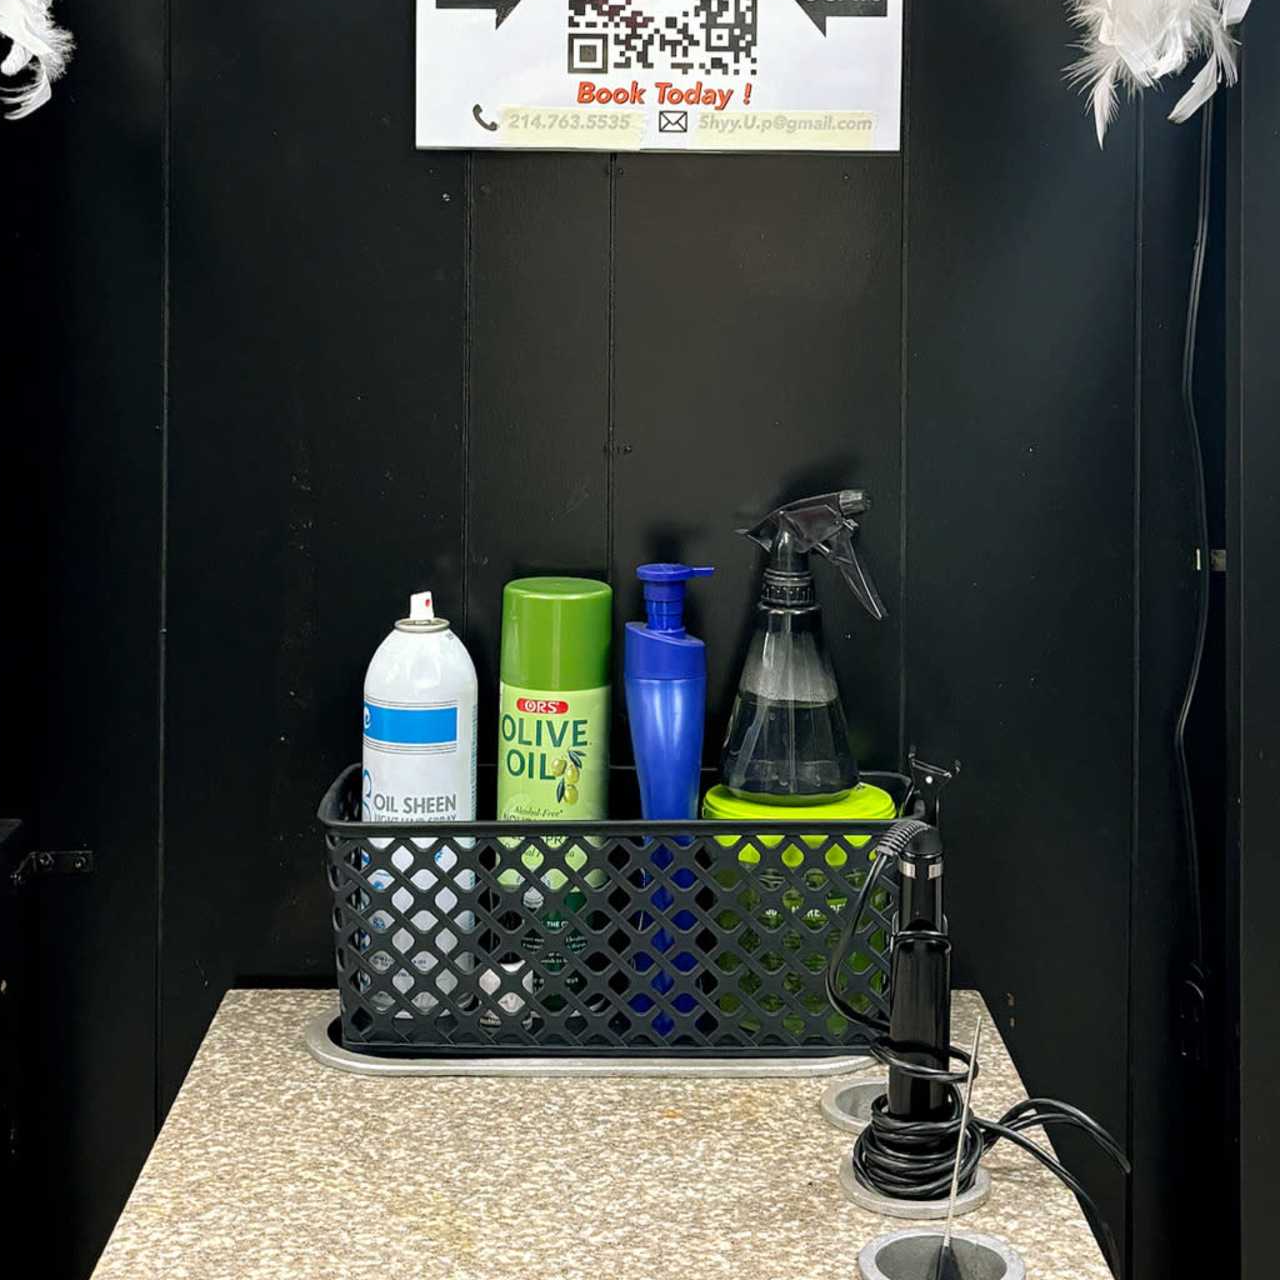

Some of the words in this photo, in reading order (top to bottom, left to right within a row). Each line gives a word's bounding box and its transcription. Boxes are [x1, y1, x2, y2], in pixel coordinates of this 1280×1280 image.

[577, 81, 645, 105] Book
[655, 82, 733, 110] Today
[508, 114, 631, 130] 214.763.5535
[525, 701, 558, 713] ORS
[502, 714, 588, 747] OLIVE
[507, 749, 556, 780] OIL
[374, 794, 398, 812] OIL
[403, 794, 456, 814] SHEEN
